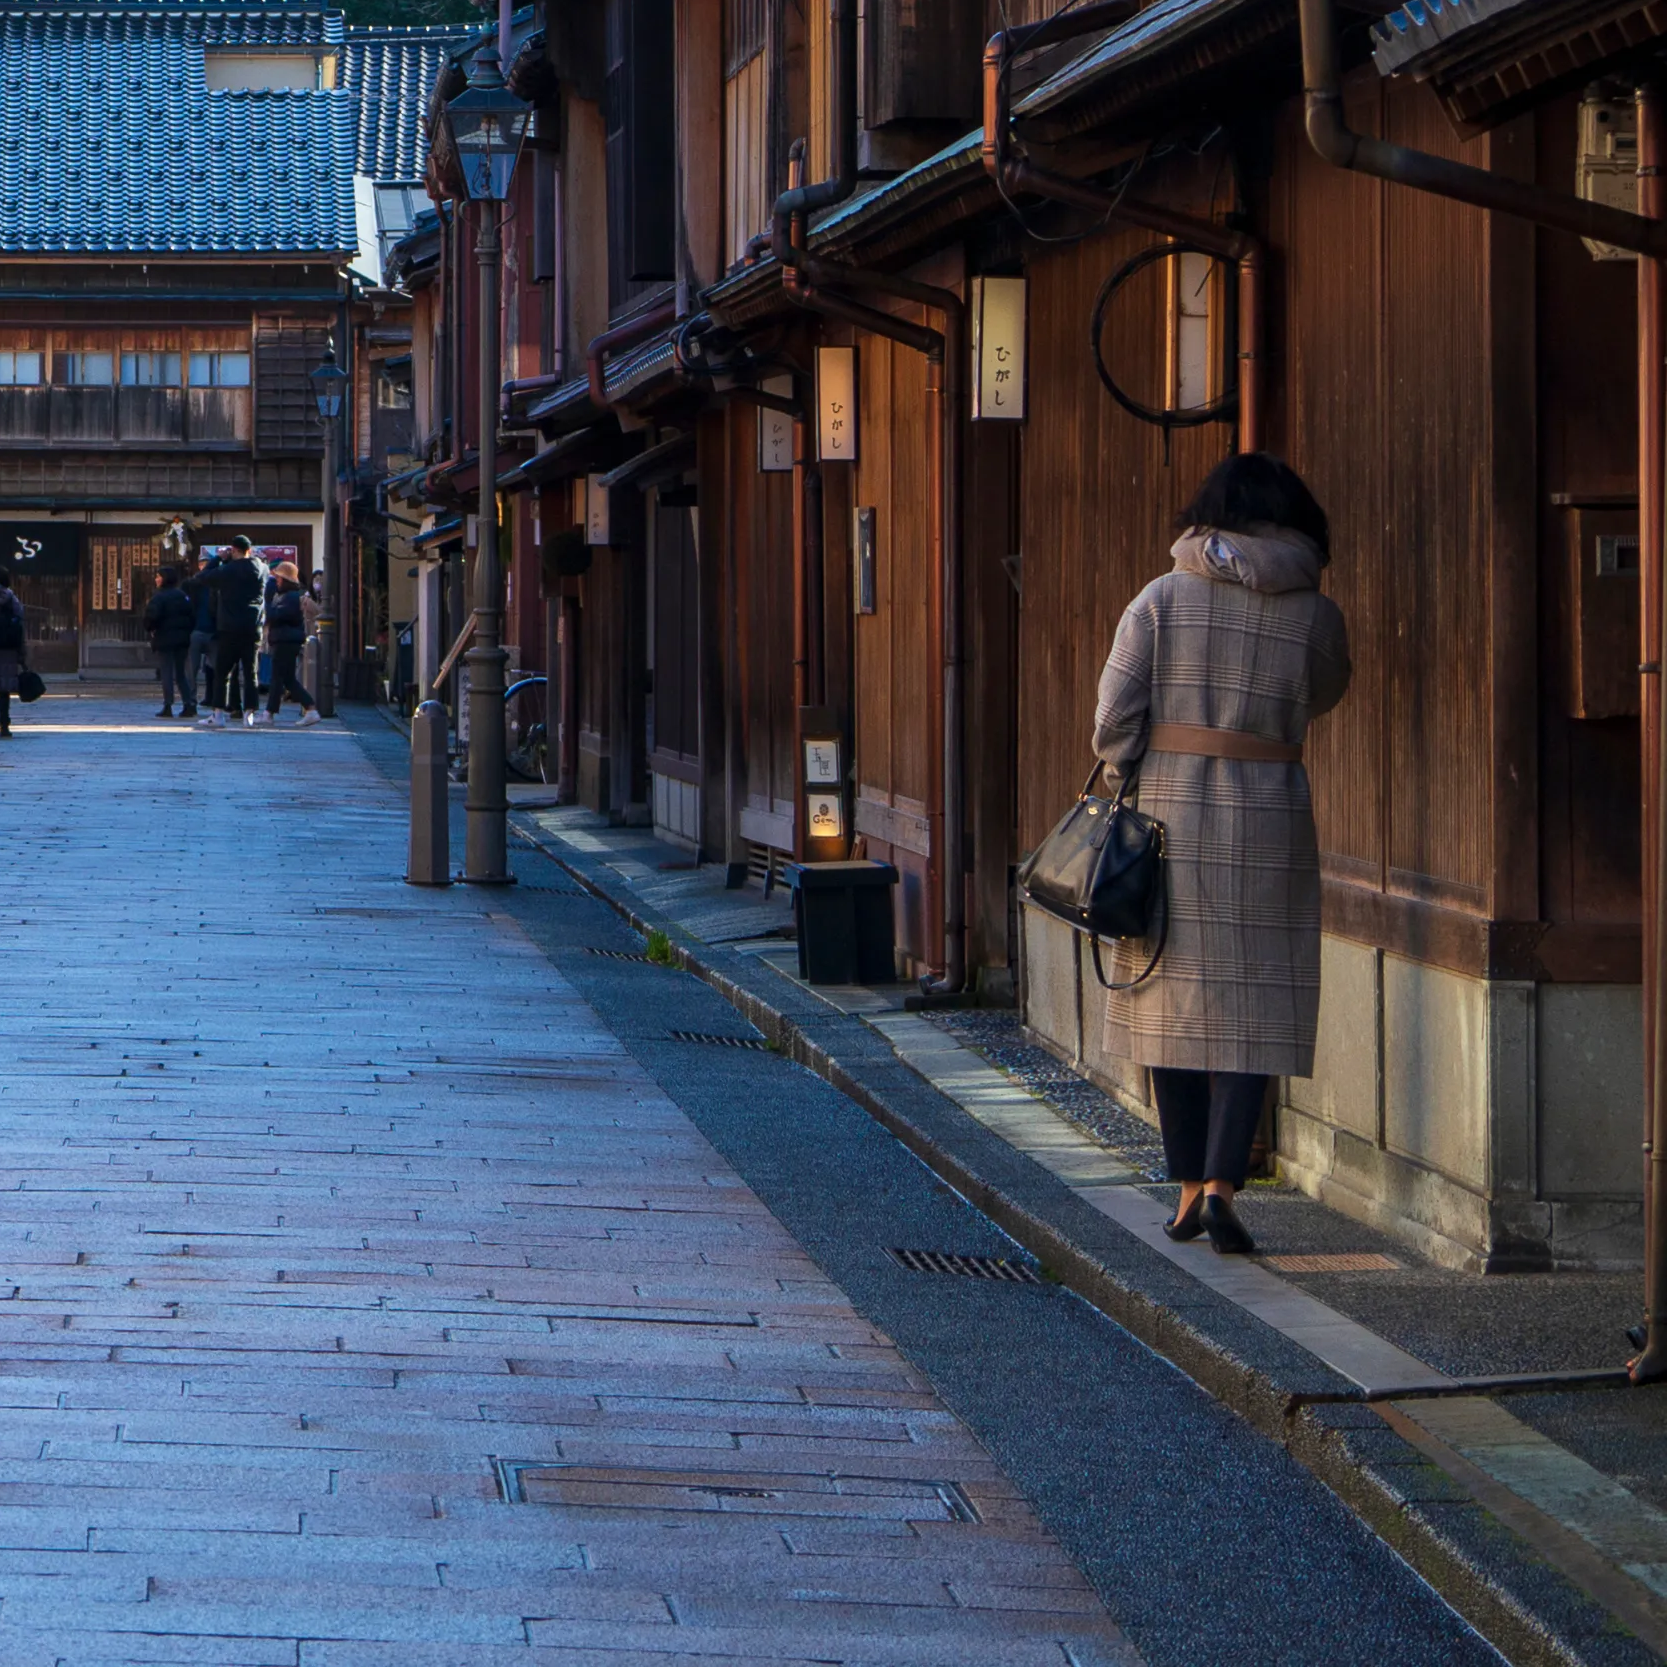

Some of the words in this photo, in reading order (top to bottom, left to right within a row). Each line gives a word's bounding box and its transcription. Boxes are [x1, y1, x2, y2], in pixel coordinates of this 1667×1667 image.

[994, 346, 1011, 406] ひがし
[771, 423, 786, 463] ひがし
[831, 401, 843, 449] ひがし
